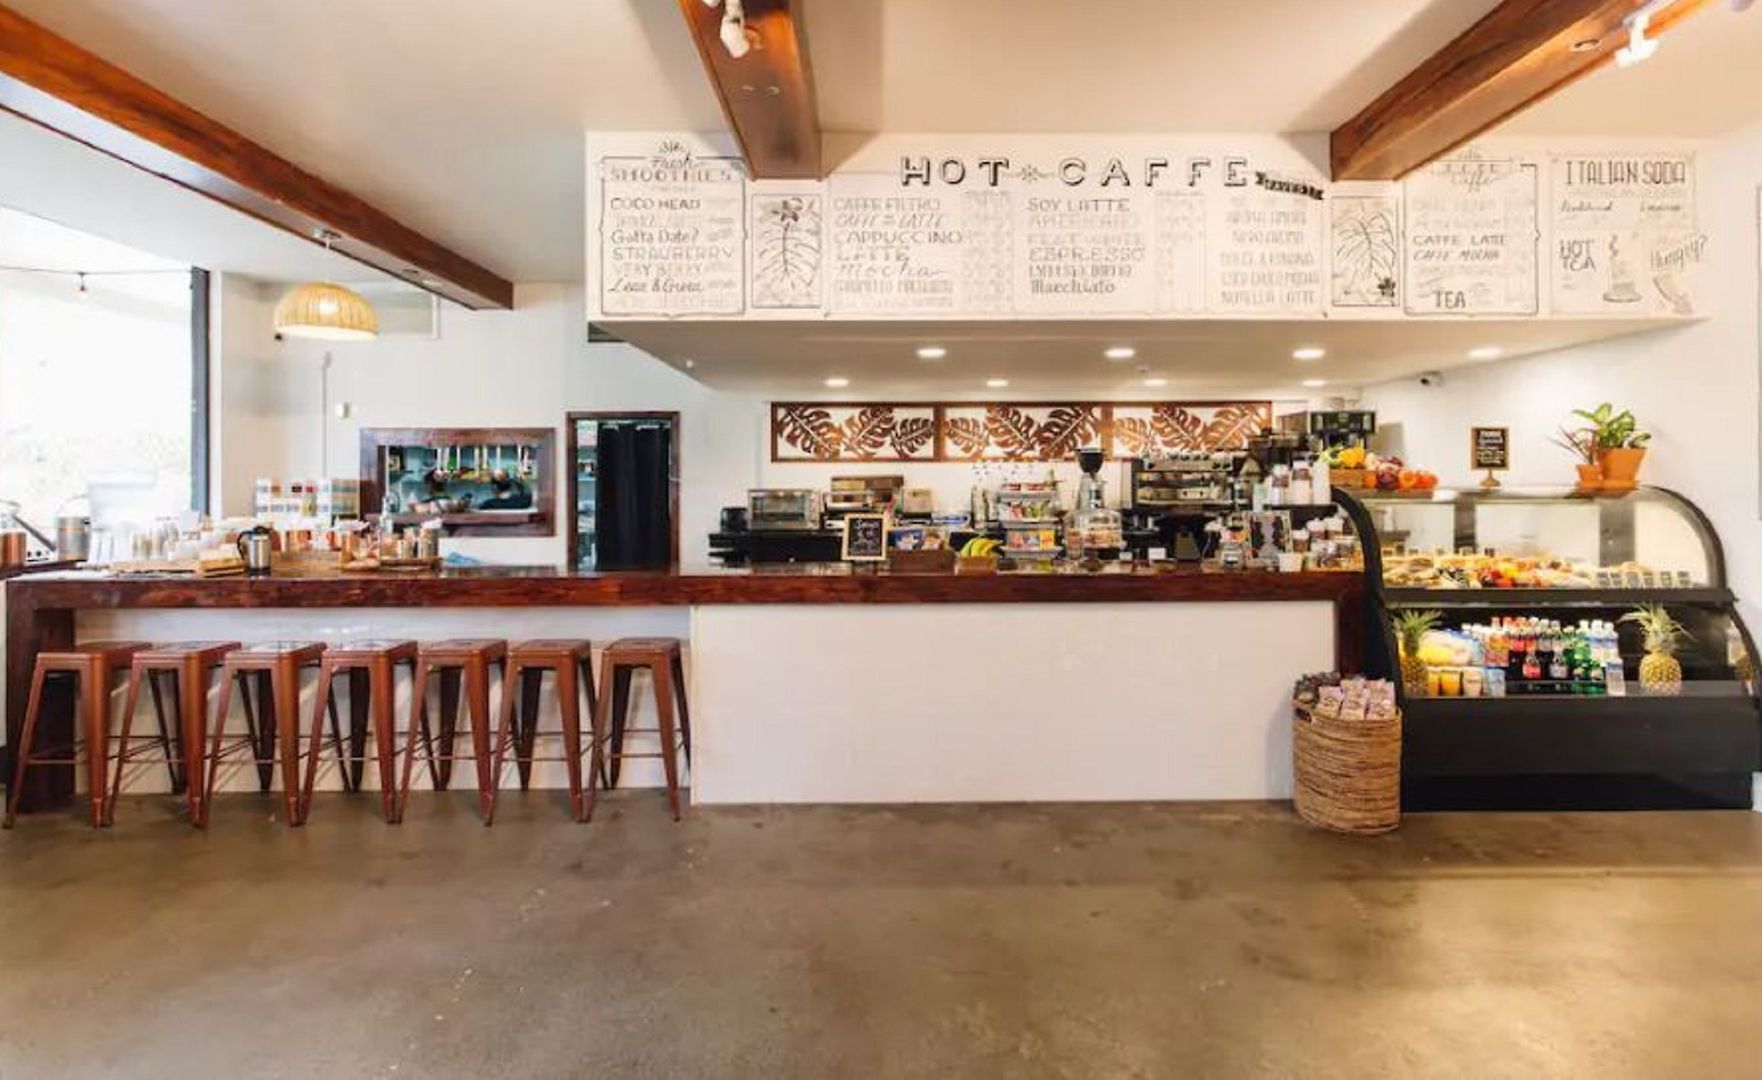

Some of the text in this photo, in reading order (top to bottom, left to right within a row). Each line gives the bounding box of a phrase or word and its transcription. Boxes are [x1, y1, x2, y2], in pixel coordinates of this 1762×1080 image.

[611, 167, 732, 181] SMOOTHIES
[901, 155, 1009, 187] HOT
[1058, 156, 1248, 188] CAFFE
[1566, 160, 1687, 186] ITALIAN SODA
[659, 197, 701, 211] HEAD
[1026, 197, 1131, 212] SOY LATTE
[833, 230, 963, 245] CAPPUCCINO
[1029, 247, 1146, 262] ESPRESSO
[1559, 238, 1596, 258] HOT
[1560, 256, 1598, 272] TEA
[1433, 289, 1467, 310] TEA
